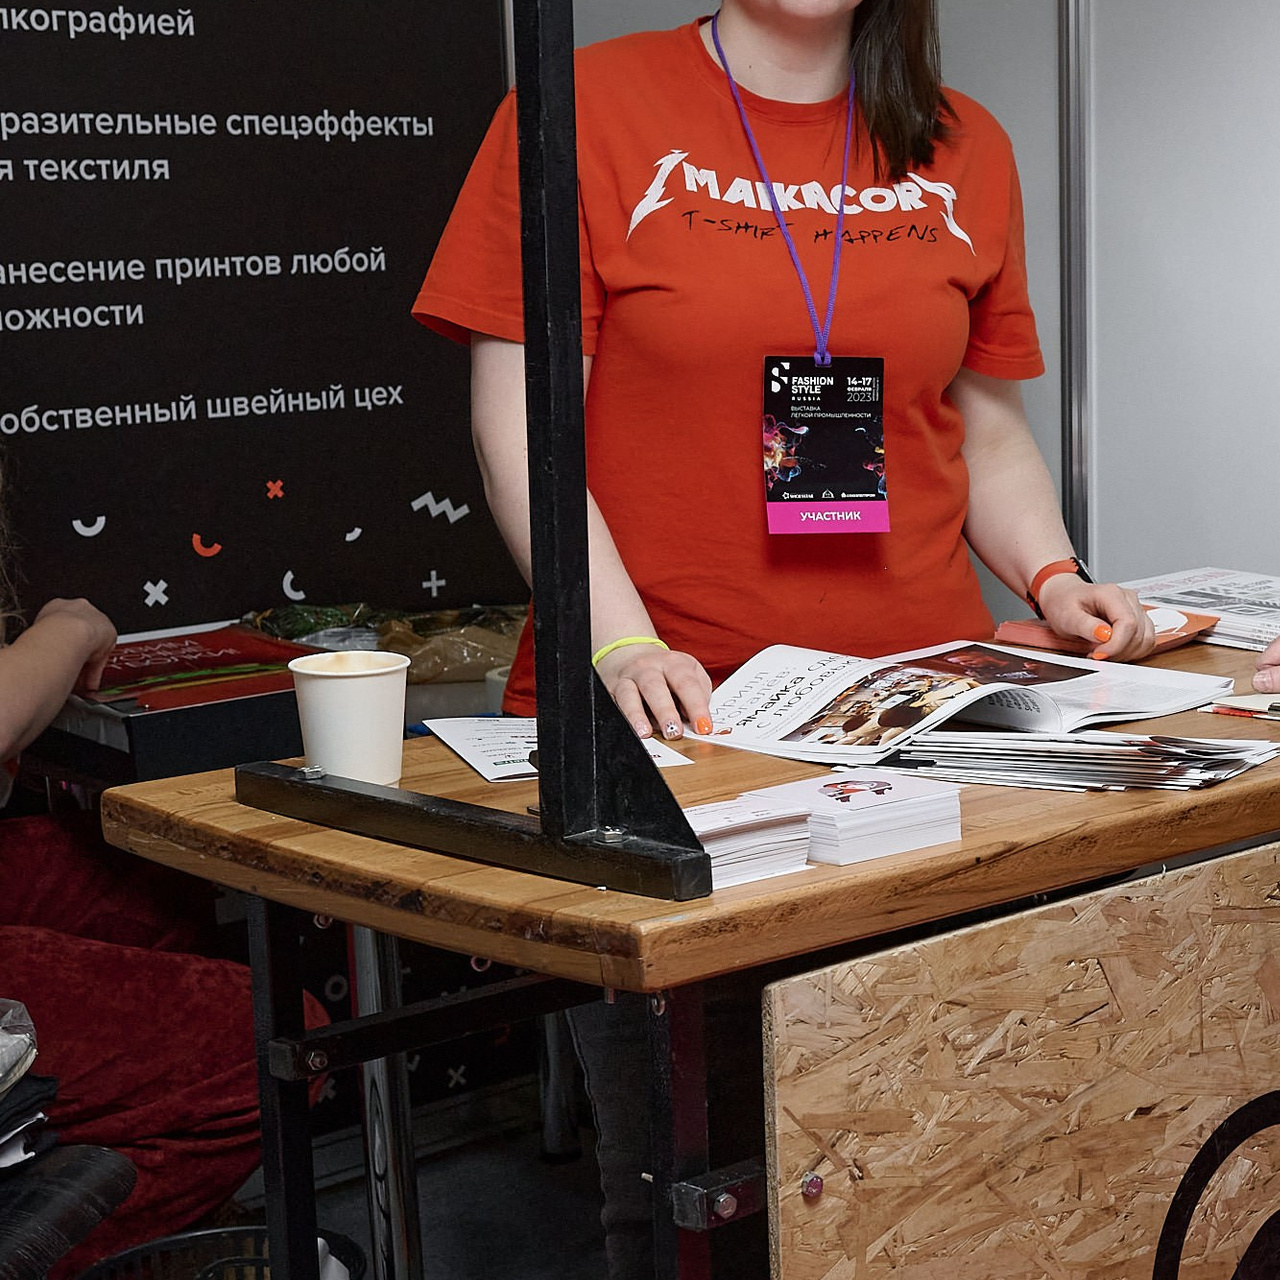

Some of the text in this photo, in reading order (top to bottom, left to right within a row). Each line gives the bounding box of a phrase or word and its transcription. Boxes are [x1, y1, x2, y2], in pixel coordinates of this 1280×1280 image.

[0, 109, 434, 142] разительные спецэффекты
[24, 159, 170, 181] текстиля
[155, 254, 282, 285] принтов
[291, 246, 386, 276] любой
[0, 304, 144, 332] ожности
[791, 376, 834, 386] FASHION
[791, 386, 822, 394] STYLE
[846, 392, 872, 402] 2023
[0, 384, 404, 434] обственный швейный цех
[800, 511, 861, 522] УЧАСТНИК
